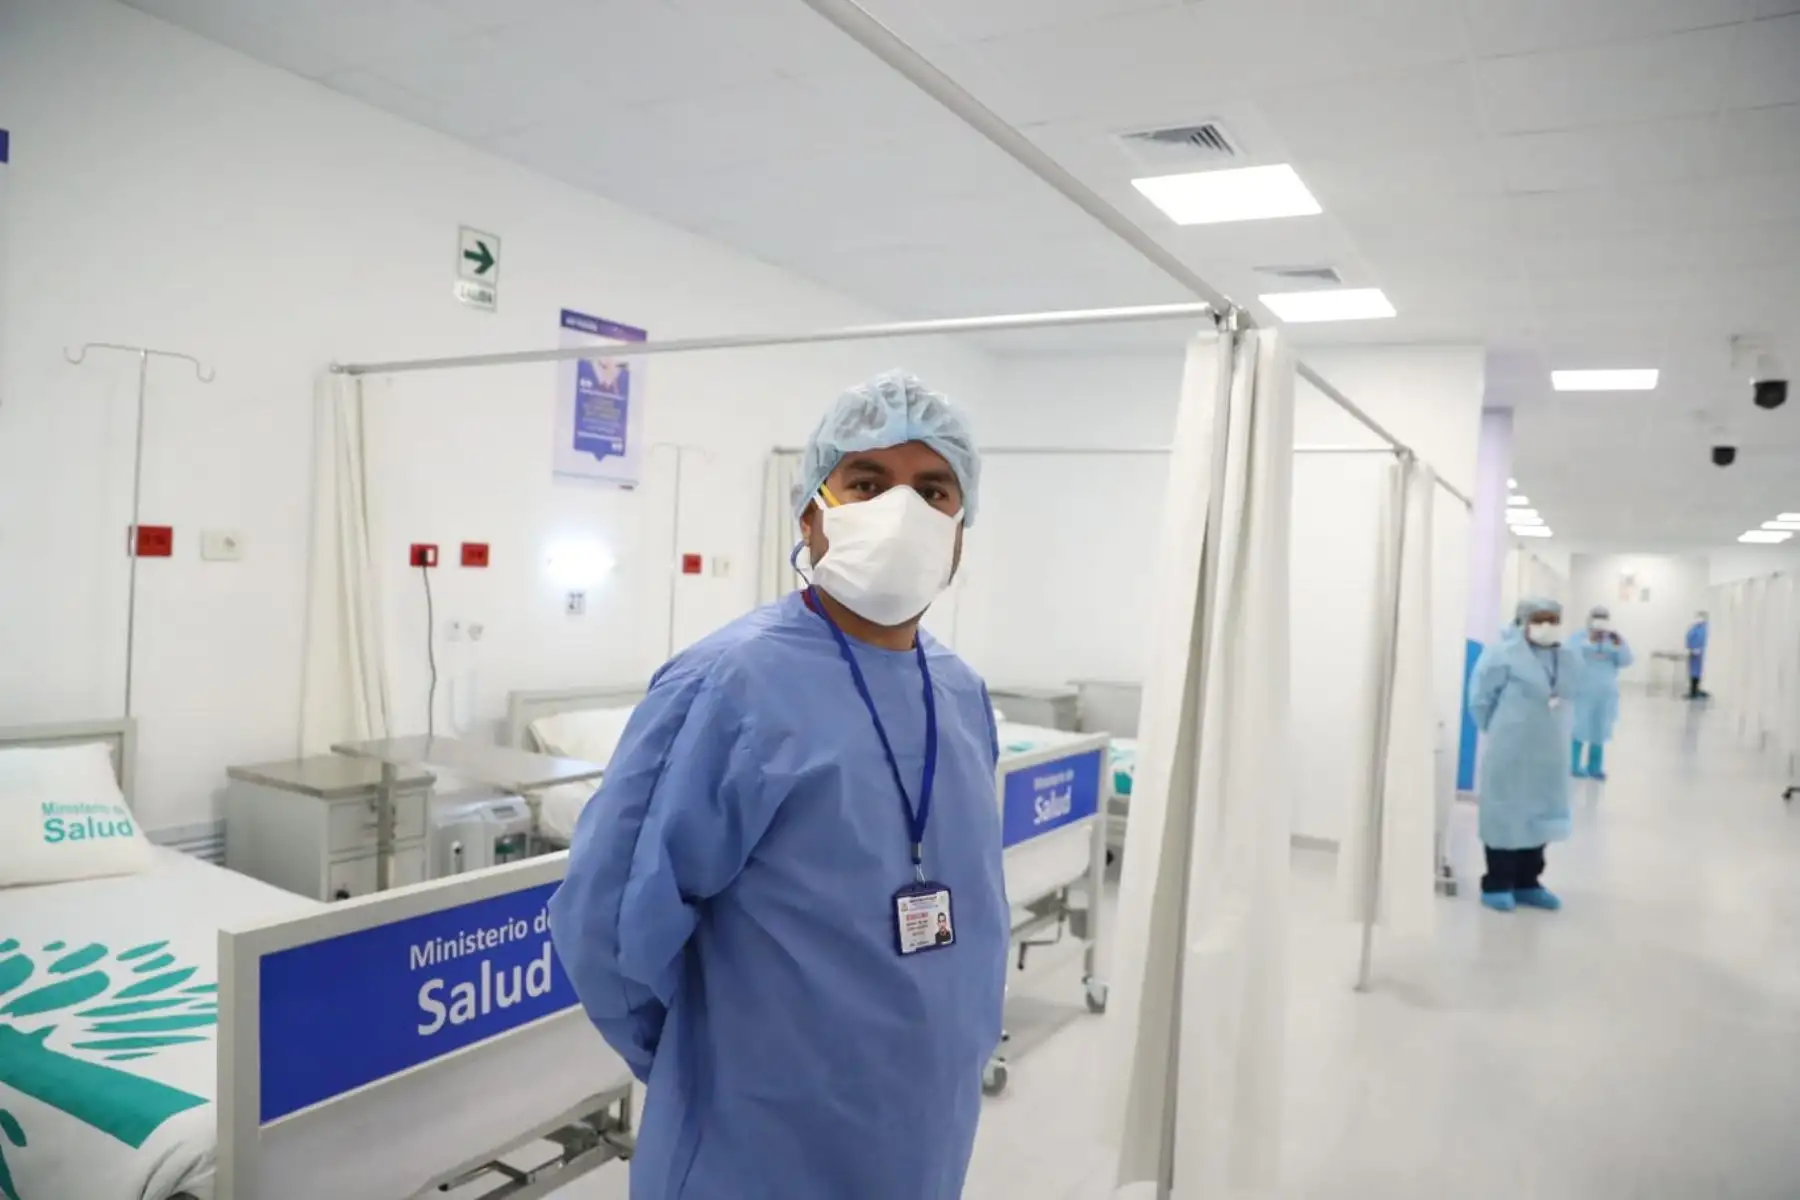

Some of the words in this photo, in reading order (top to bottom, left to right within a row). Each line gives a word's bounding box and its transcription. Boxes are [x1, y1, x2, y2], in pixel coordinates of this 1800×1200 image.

[44, 816, 133, 843] Salud
[410, 917, 528, 971] Ministerio
[418, 941, 551, 1036] Salud
